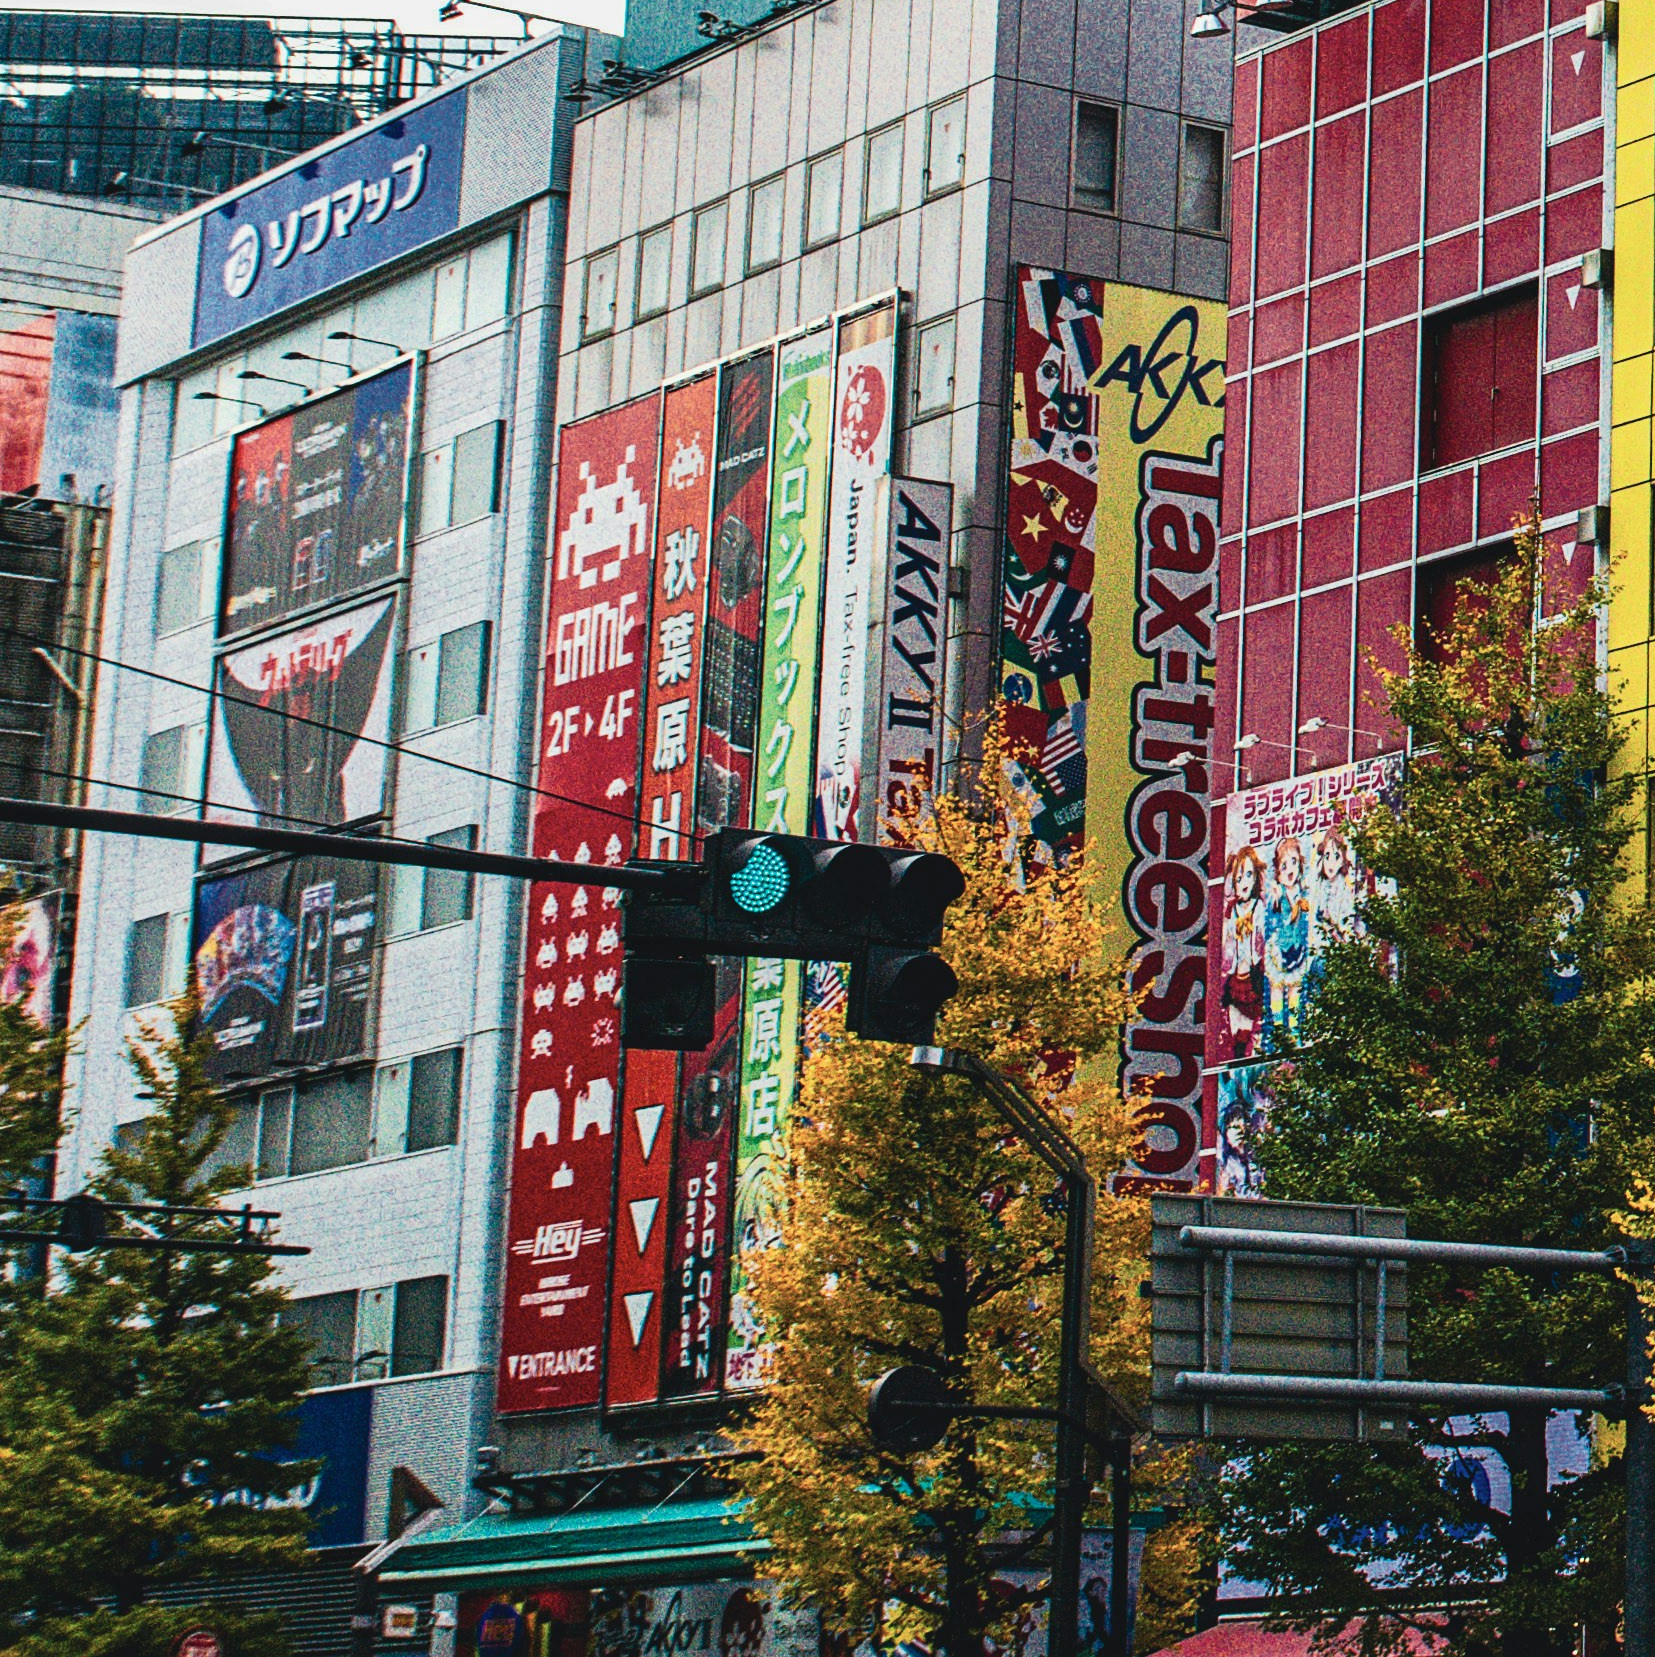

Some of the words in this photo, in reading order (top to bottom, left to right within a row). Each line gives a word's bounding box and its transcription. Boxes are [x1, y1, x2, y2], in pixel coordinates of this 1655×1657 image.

[269, 143, 429, 268] ソフマップ
[1094, 344, 1227, 408] AKK
[850, 478, 865, 574] Japan.
[764, 398, 813, 832] メロンブックス
[892, 489, 942, 692] AKKY
[555, 592, 638, 688] GAME
[652, 525, 700, 772] 秋葉原
[845, 588, 859, 698] Tax-free
[546, 705, 581, 758] 2F
[597, 689, 636, 743] 4F
[837, 705, 852, 779] Shop
[533, 1223, 583, 1259] Hey
[702, 1161, 719, 1259] MAD
[519, 1345, 598, 1380] ENTRANCE
[696, 1270, 714, 1380] CATZ
